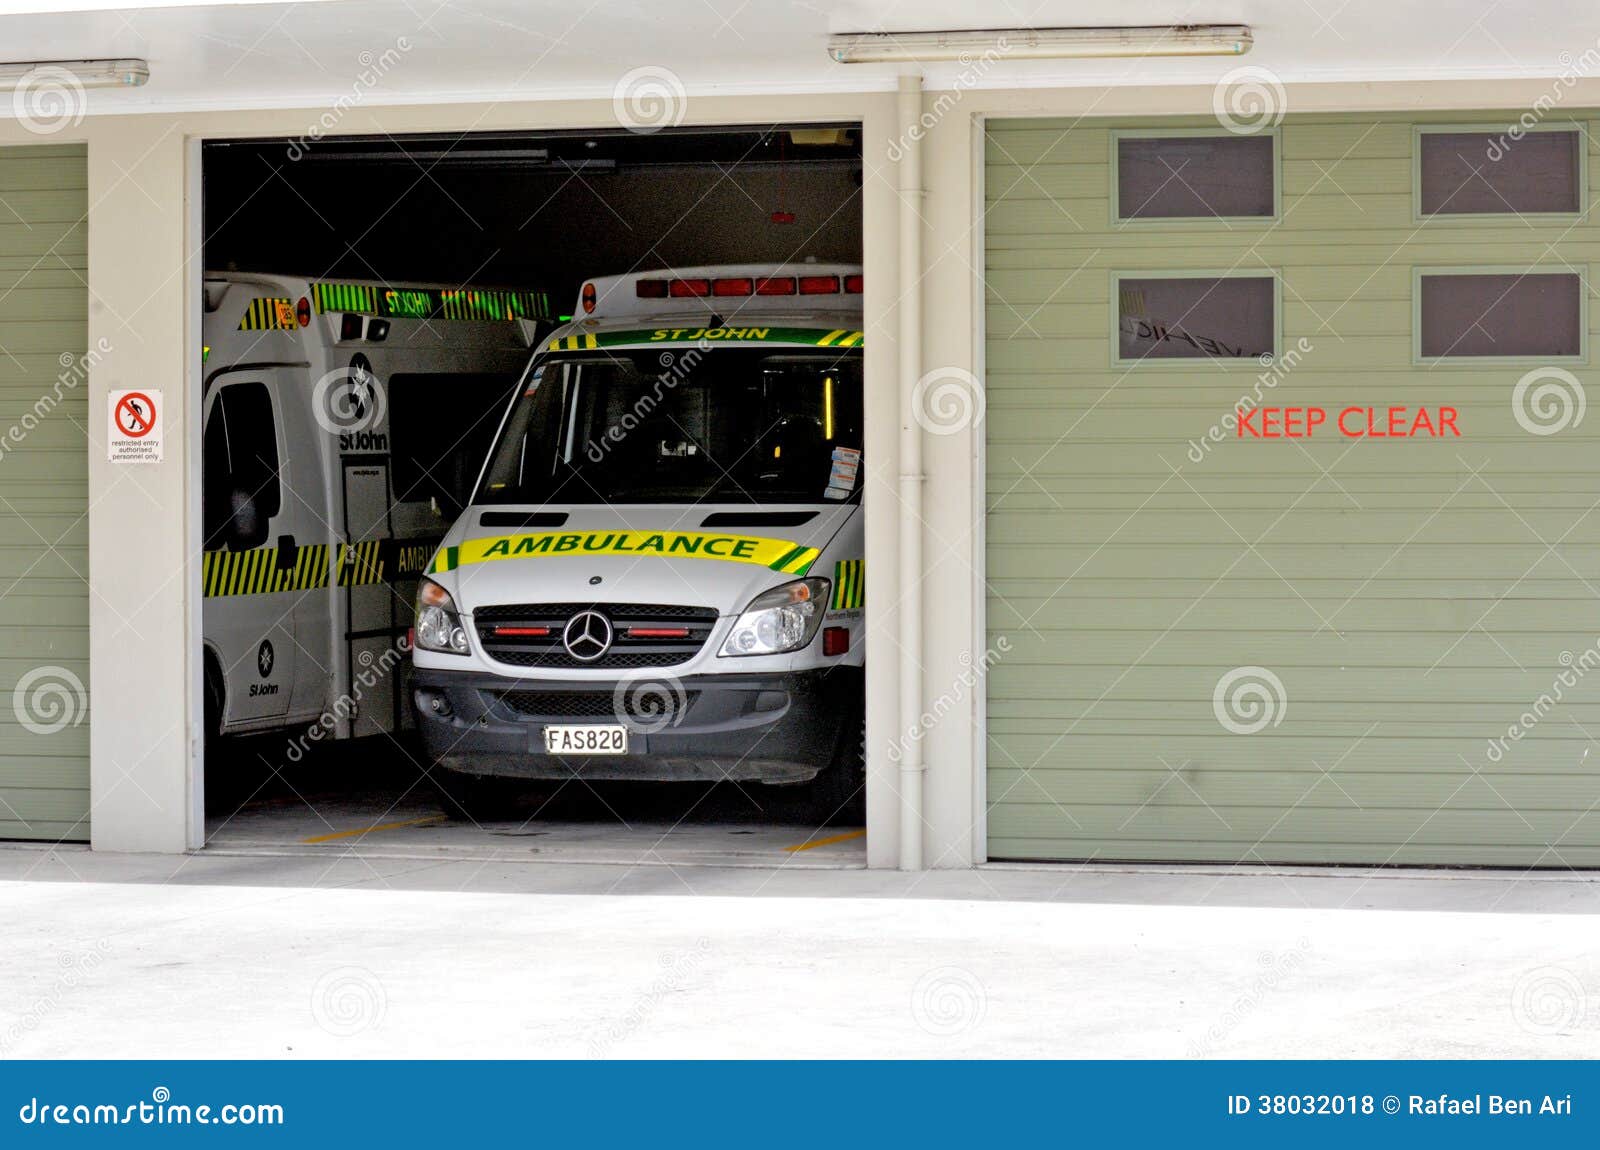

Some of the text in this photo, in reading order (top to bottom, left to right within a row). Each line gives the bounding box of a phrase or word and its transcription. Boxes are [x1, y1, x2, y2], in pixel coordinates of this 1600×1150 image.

[386, 291, 432, 314] ST JOHN
[651, 328, 770, 340] ST JOHN
[1237, 406, 1461, 438] KEEP CLEAR
[481, 534, 759, 558] AMBULANCE
[399, 545, 437, 573] AMBU
[548, 730, 623, 750] FAS820
